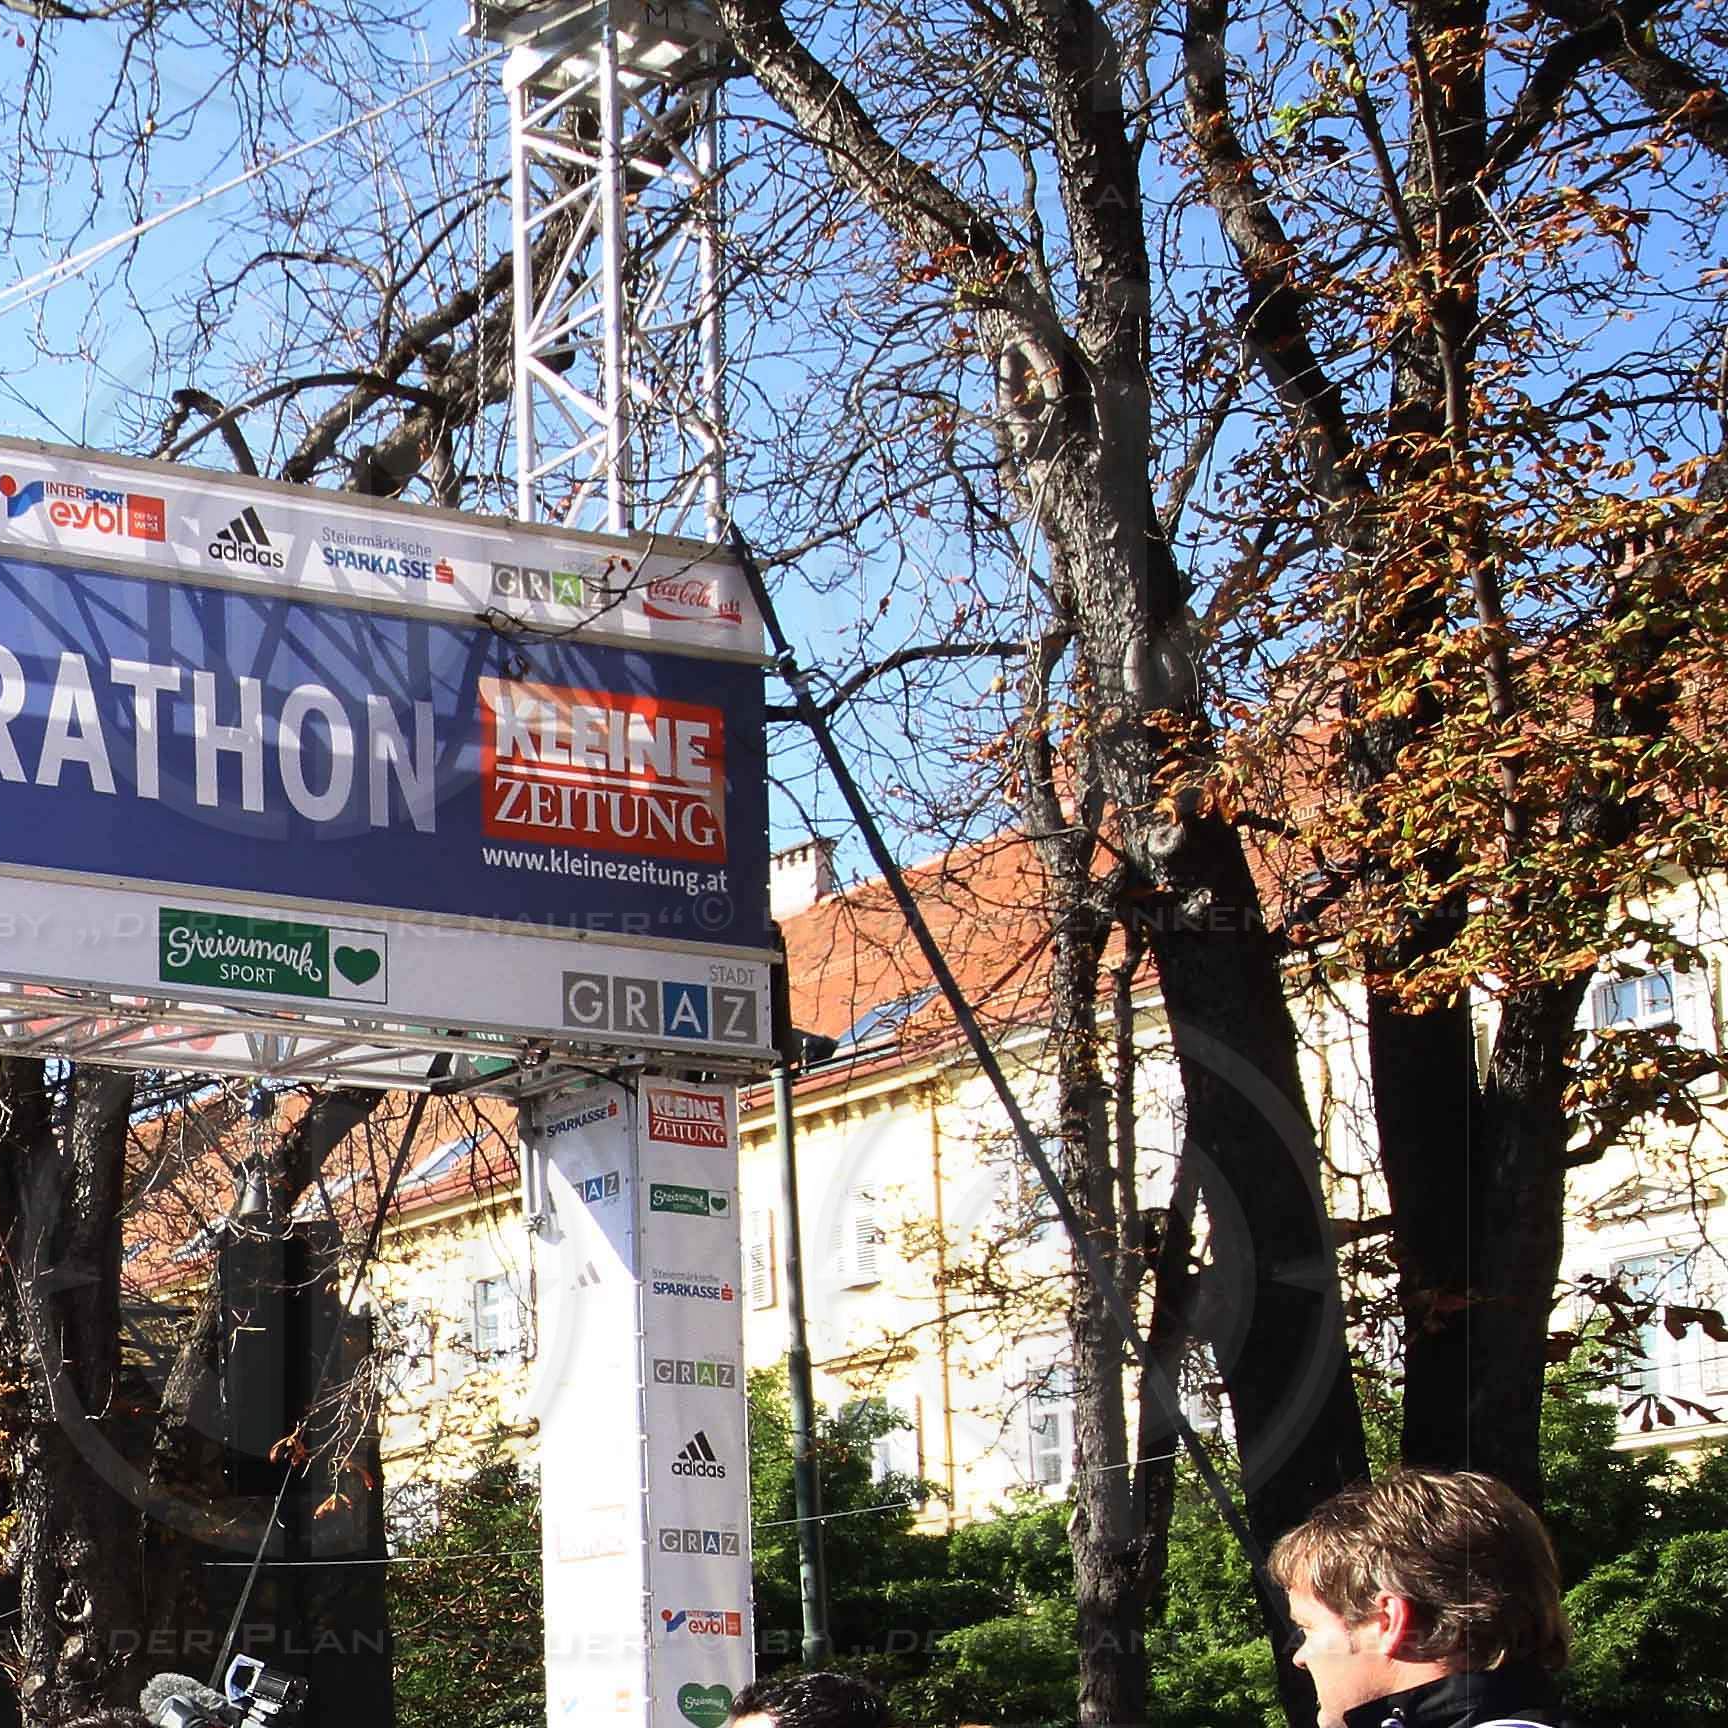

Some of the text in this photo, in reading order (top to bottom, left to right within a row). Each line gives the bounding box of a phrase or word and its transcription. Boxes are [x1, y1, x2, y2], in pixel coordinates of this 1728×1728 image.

[45, 481, 127, 506] INTERSPORT
[49, 500, 124, 536] eybl
[209, 539, 285, 569] adidas
[321, 528, 433, 557] Steiermärkische
[322, 549, 433, 581] SPARKASSE
[494, 691, 712, 784] KLEINE
[493, 777, 715, 848] ZEITUNG
[481, 844, 729, 895] www.kleinezeitung.at
[166, 926, 323, 983] Steiermark
[219, 963, 277, 985] SPORT
[707, 962, 757, 984] STADT
[568, 979, 756, 1039] GRAZ
[651, 1094, 722, 1121] KLEINE
[546, 1108, 608, 1138] SPARKASSE
[652, 1119, 726, 1144] ZEITUNG
[652, 1282, 721, 1301] SPARKASSE
[655, 1361, 735, 1386] GRAZ
[671, 1460, 727, 1479] adidas
[661, 1530, 739, 1555] GRAZ
[687, 1618, 725, 1635] eybl
